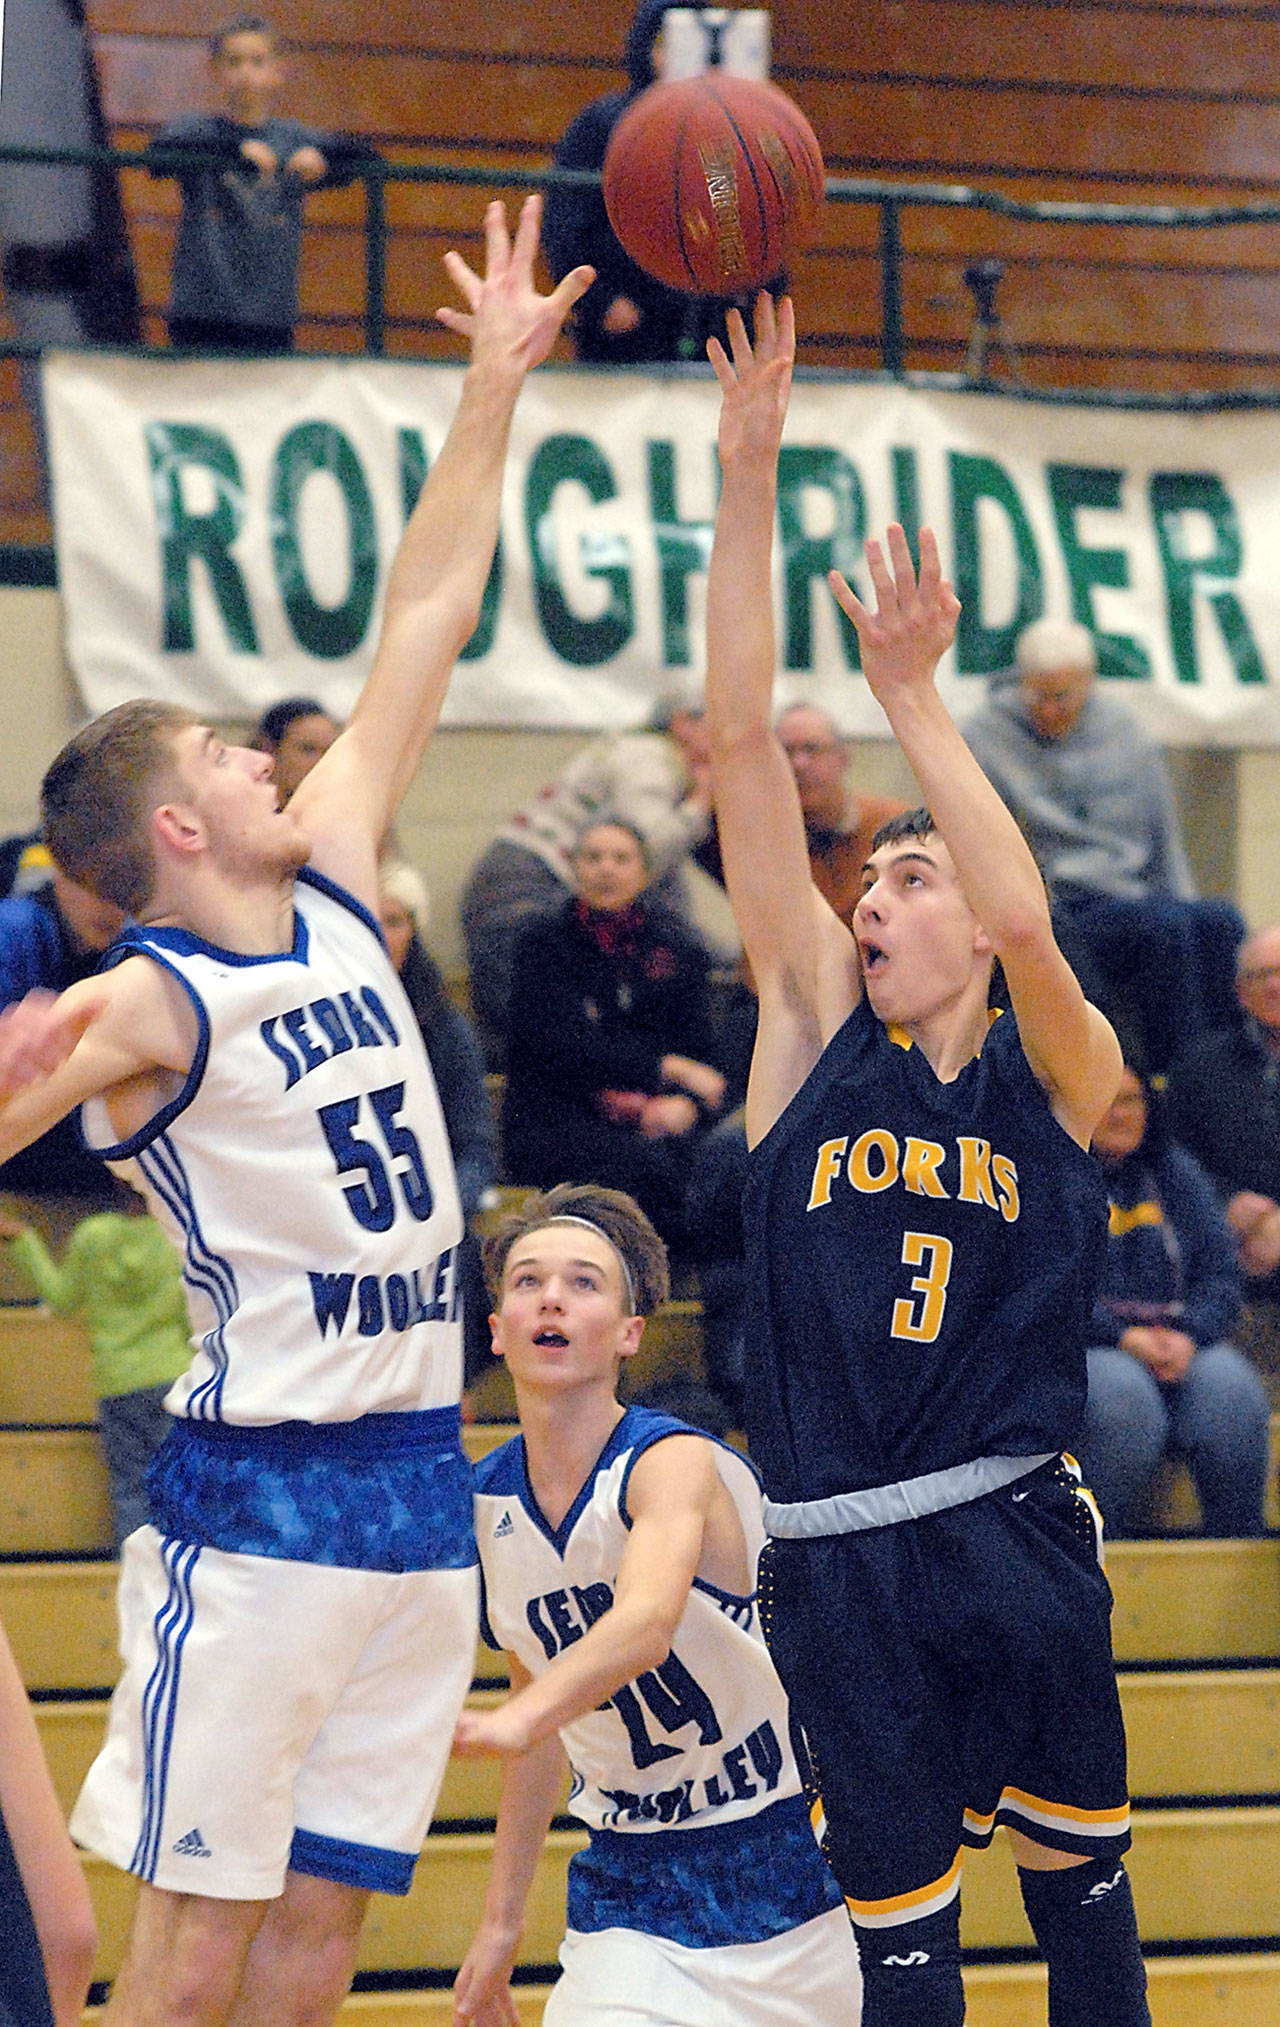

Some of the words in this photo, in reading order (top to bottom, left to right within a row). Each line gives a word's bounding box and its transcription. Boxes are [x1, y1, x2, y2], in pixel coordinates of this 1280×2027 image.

[316, 1080, 433, 1232] 55
[806, 1128, 1020, 1222] FORKS
[890, 1231, 953, 1343] 3
[526, 1582, 615, 1661] SED
